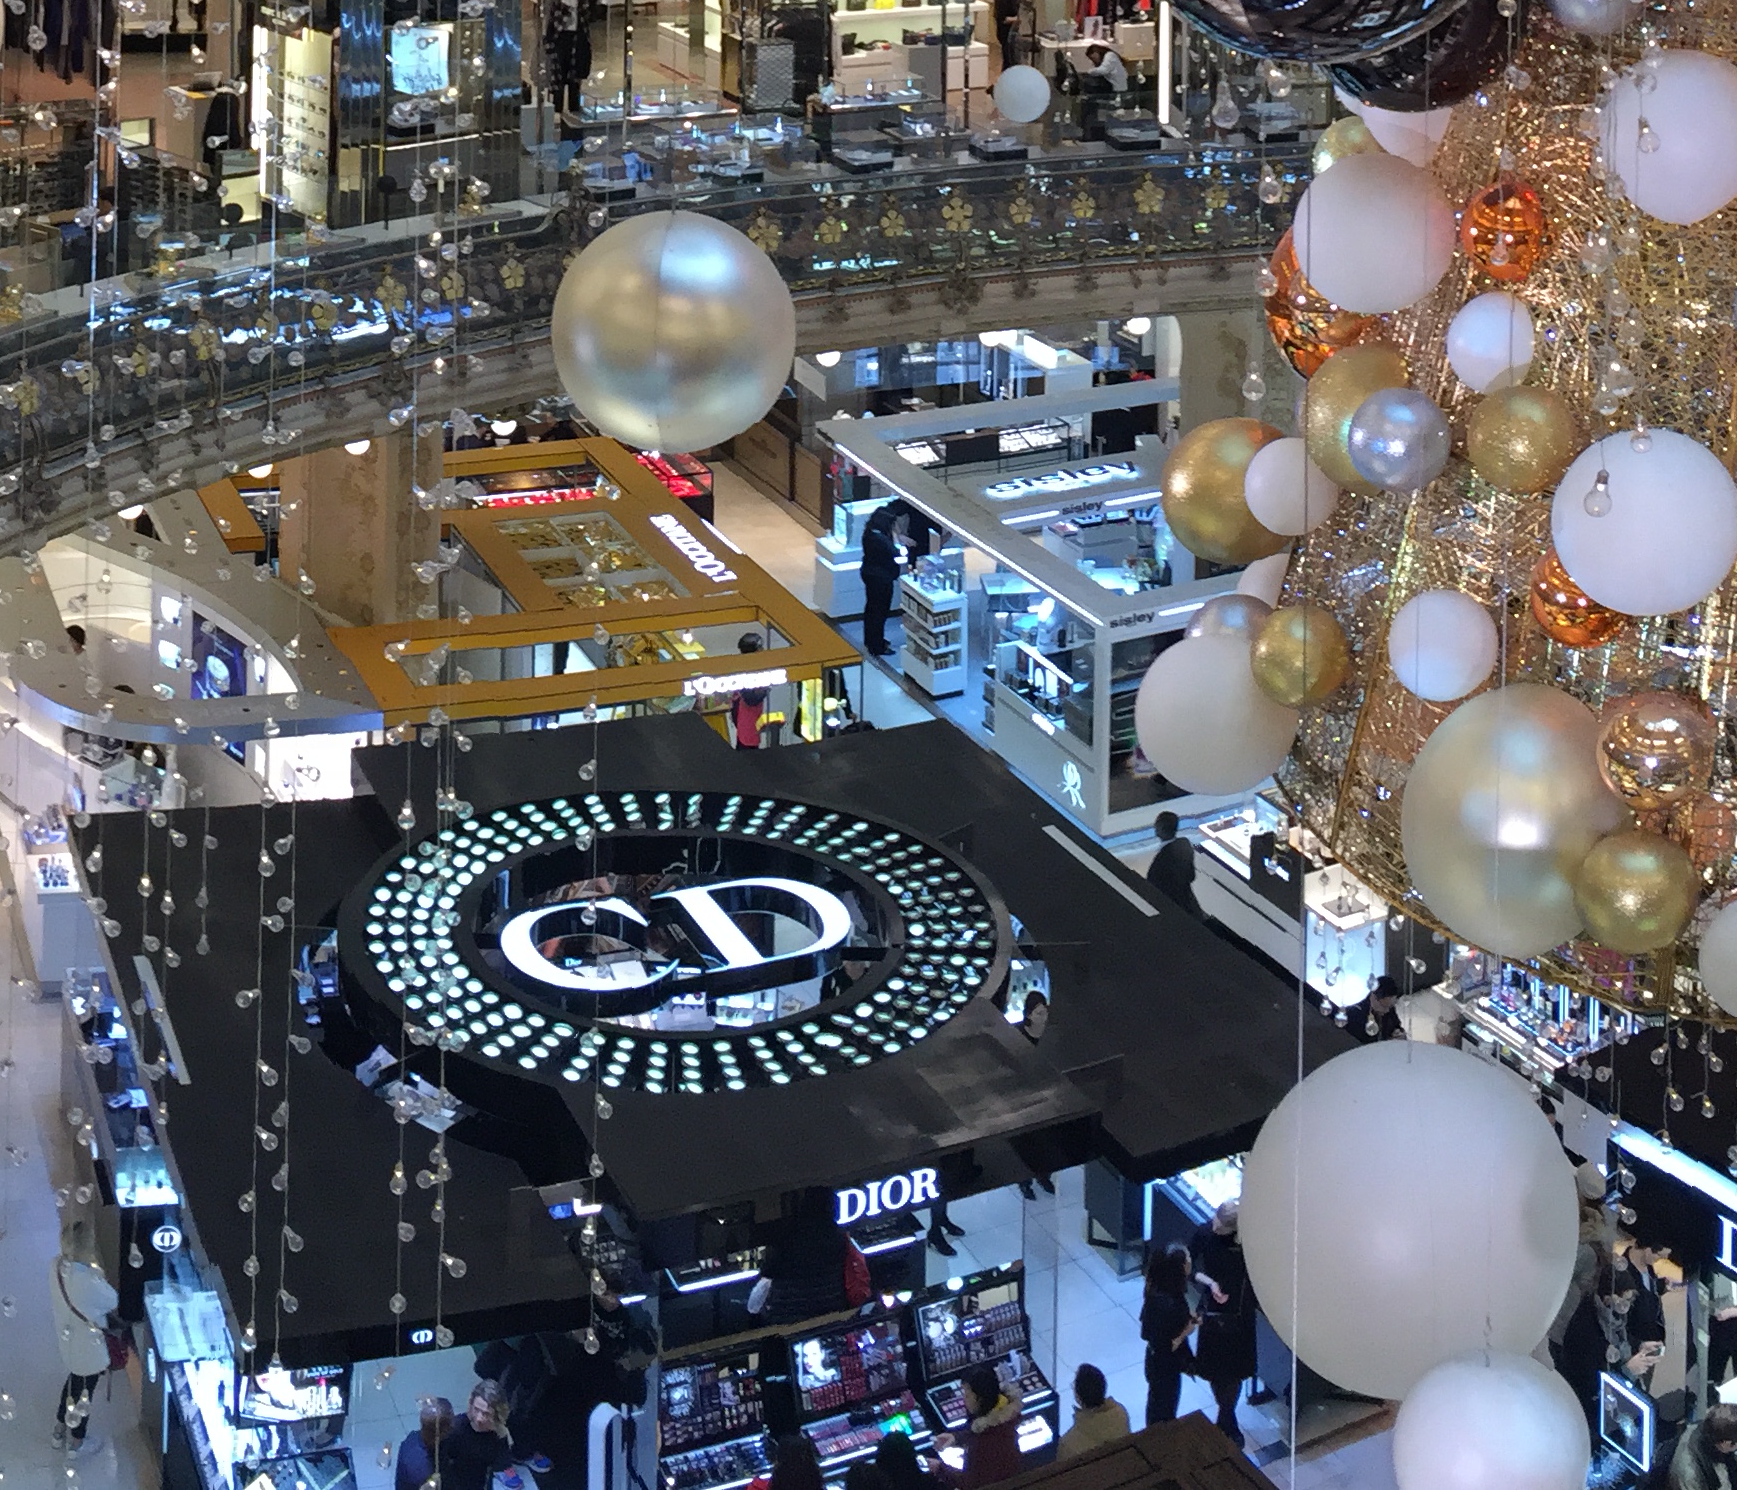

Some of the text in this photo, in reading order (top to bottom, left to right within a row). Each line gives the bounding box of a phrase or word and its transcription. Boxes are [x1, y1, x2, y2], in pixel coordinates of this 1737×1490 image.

[988, 460, 1137, 494] sisley
[1062, 500, 1104, 515] sisley
[1109, 610, 1156, 629] sisley
[836, 1167, 941, 1225] DIOR
